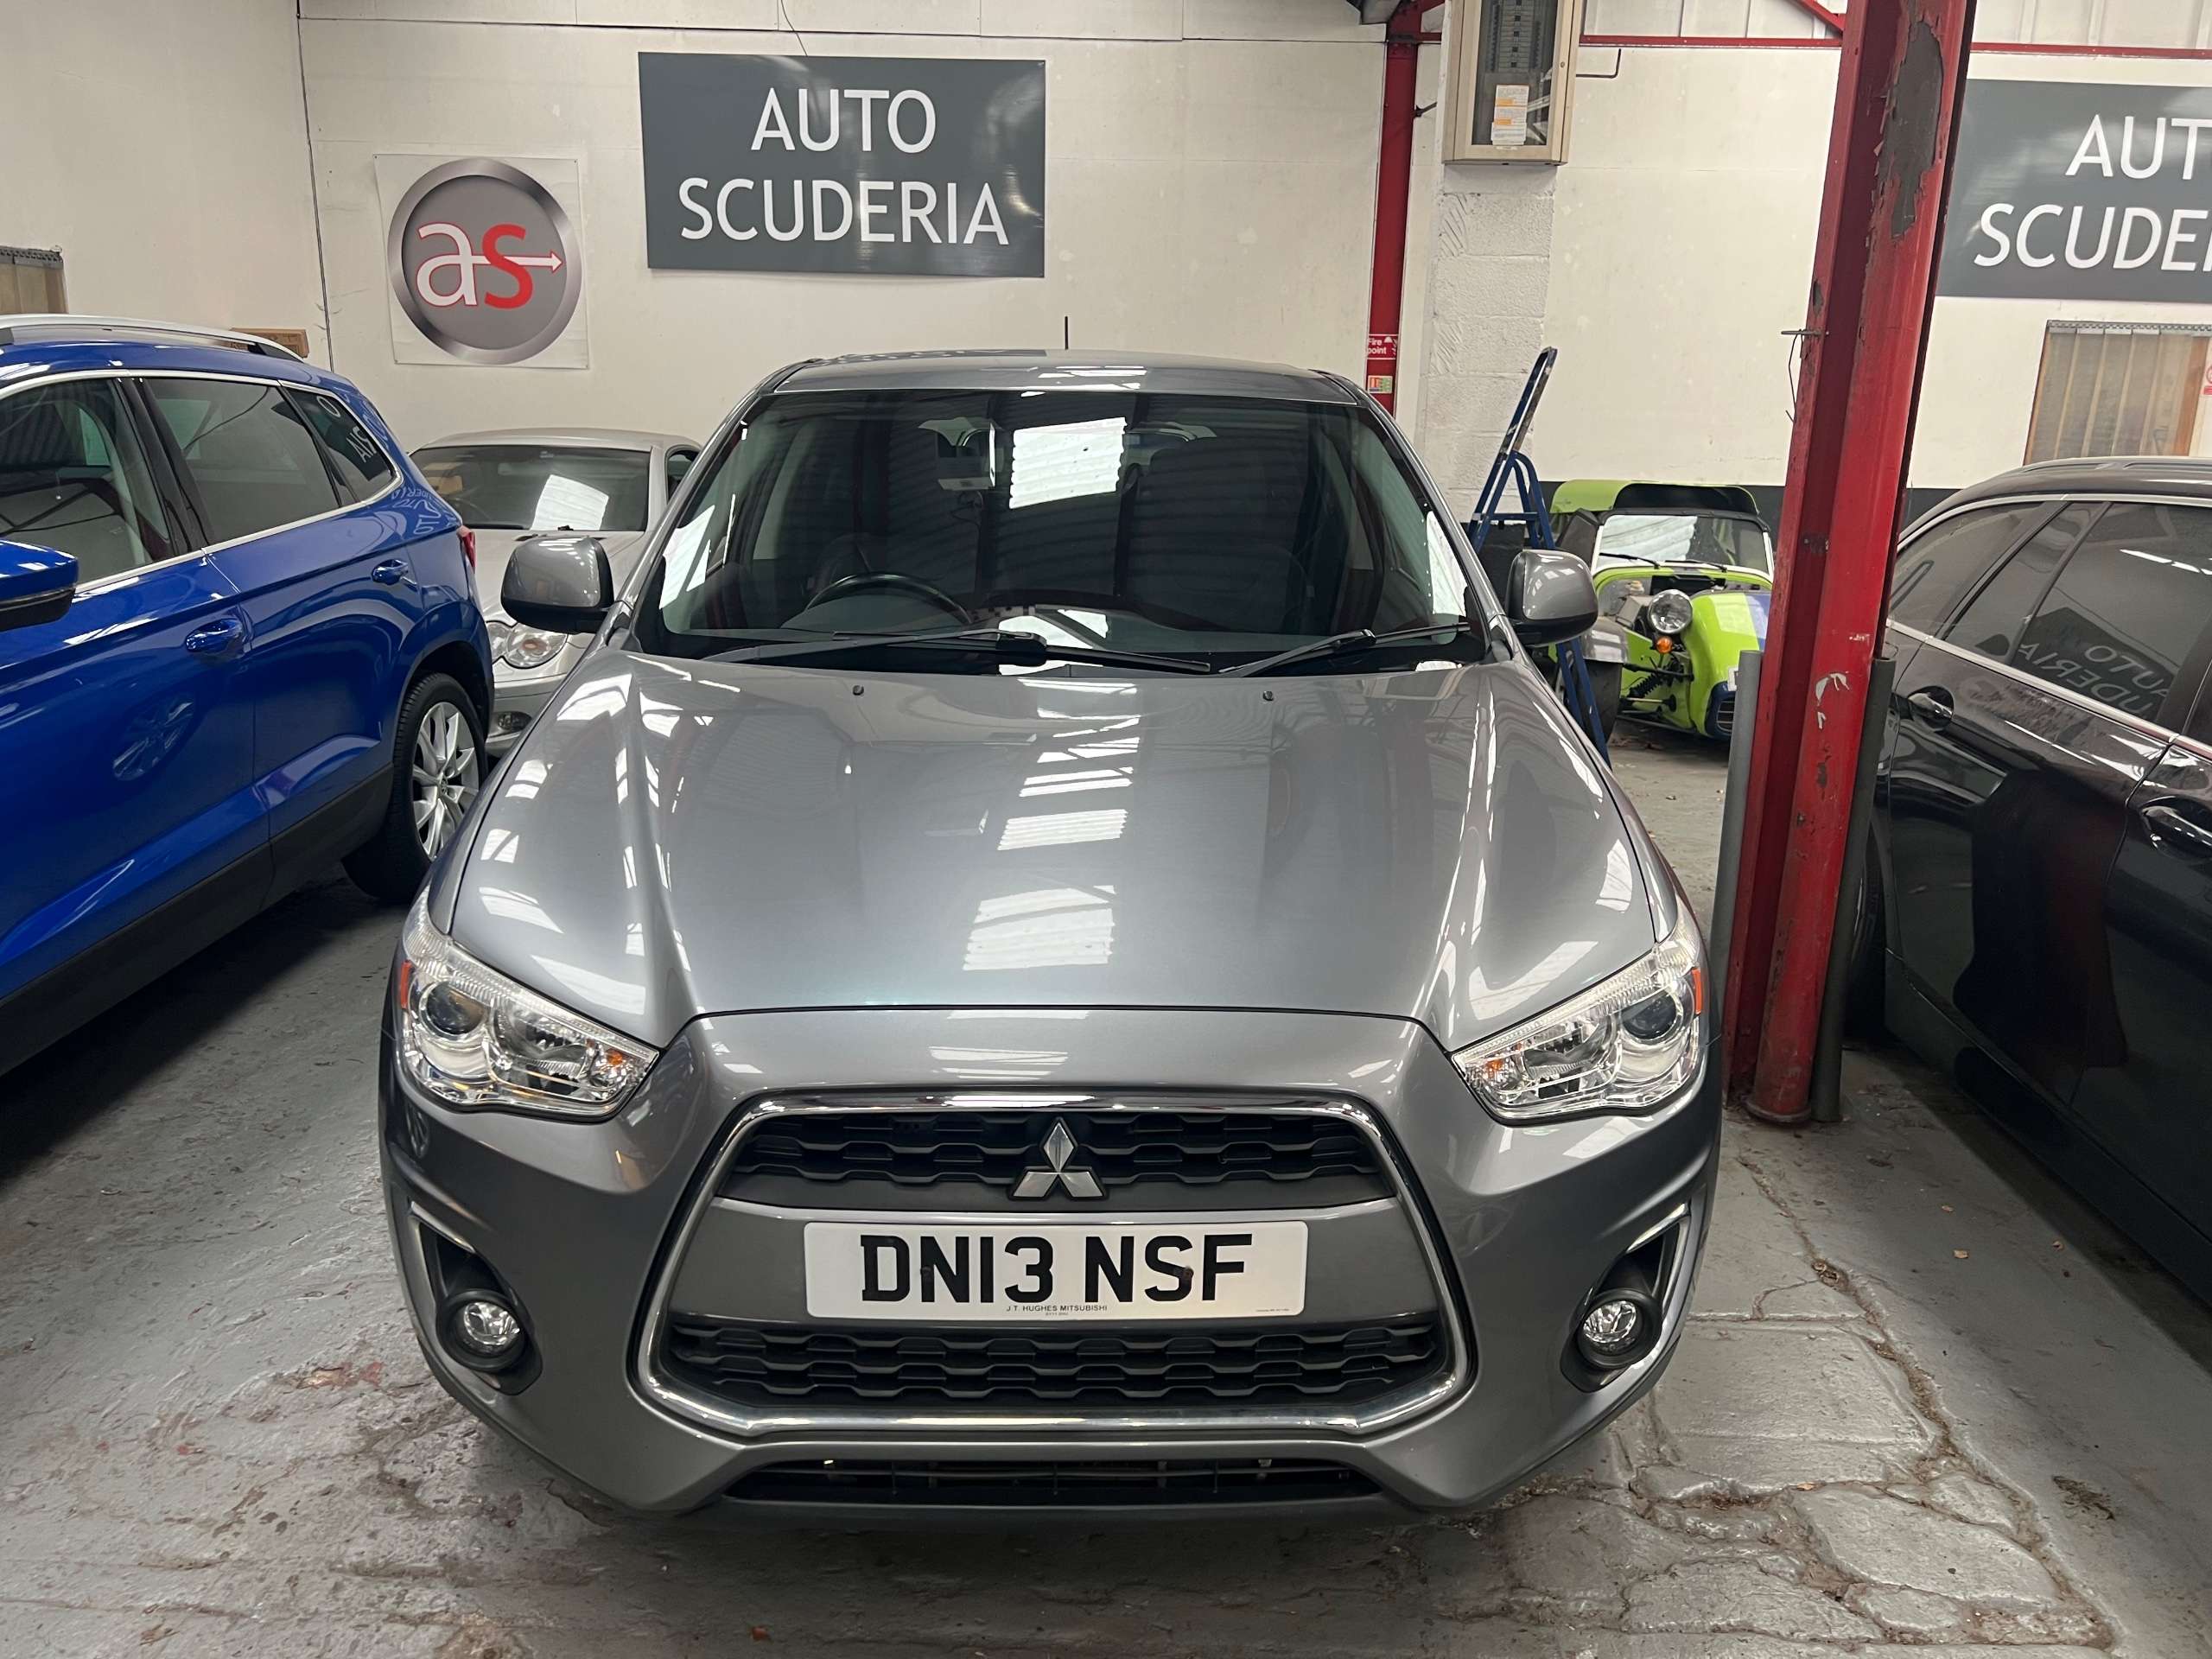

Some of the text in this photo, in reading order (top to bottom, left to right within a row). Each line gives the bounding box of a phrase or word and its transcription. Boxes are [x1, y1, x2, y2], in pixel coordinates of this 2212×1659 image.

[750, 87, 937, 154] AUTO
[2064, 113, 2212, 181] AUT
[678, 176, 1010, 246] SCUDERIA
[416, 221, 534, 310] as
[860, 1233, 1253, 1303] DN13 NSF
